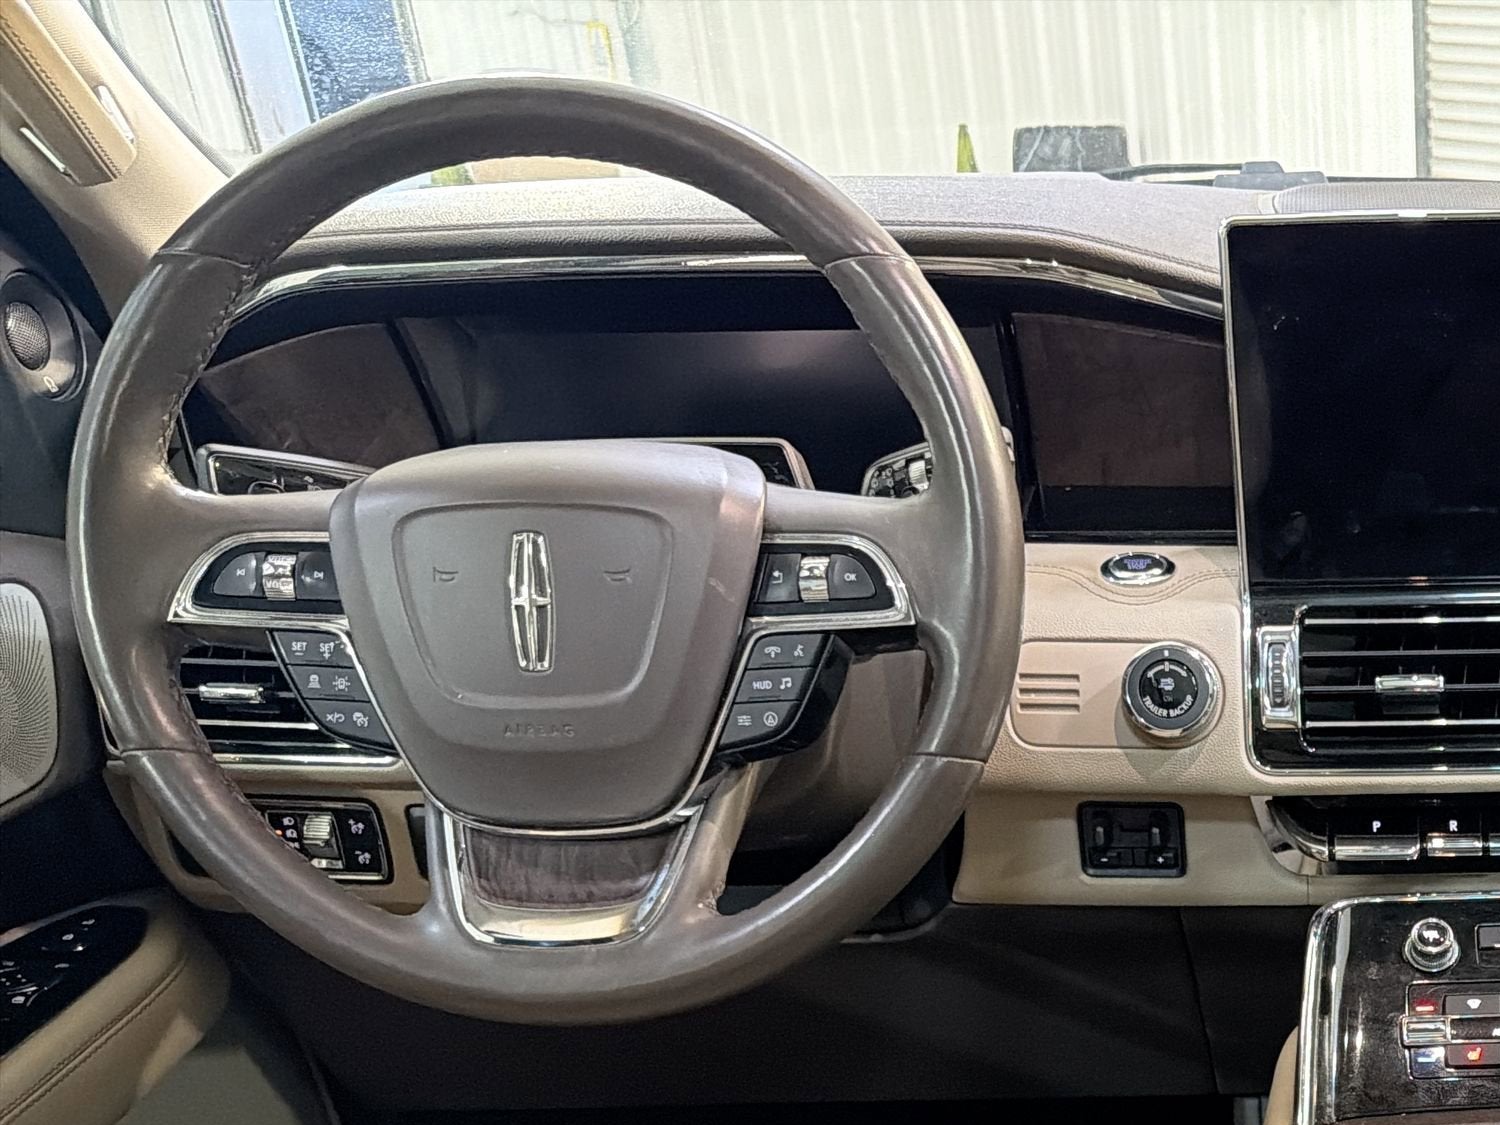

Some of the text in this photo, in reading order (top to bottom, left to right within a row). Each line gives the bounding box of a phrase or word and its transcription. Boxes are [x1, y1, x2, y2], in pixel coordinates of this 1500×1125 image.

[843, 572, 857, 582] OK
[291, 641, 308, 651] SET
[319, 641, 335, 652] SET
[752, 680, 773, 690] HUD
[1142, 694, 1194, 718] TRAILER BACKUP
[1371, 820, 1382, 833] P
[1449, 820, 1459, 832] R
